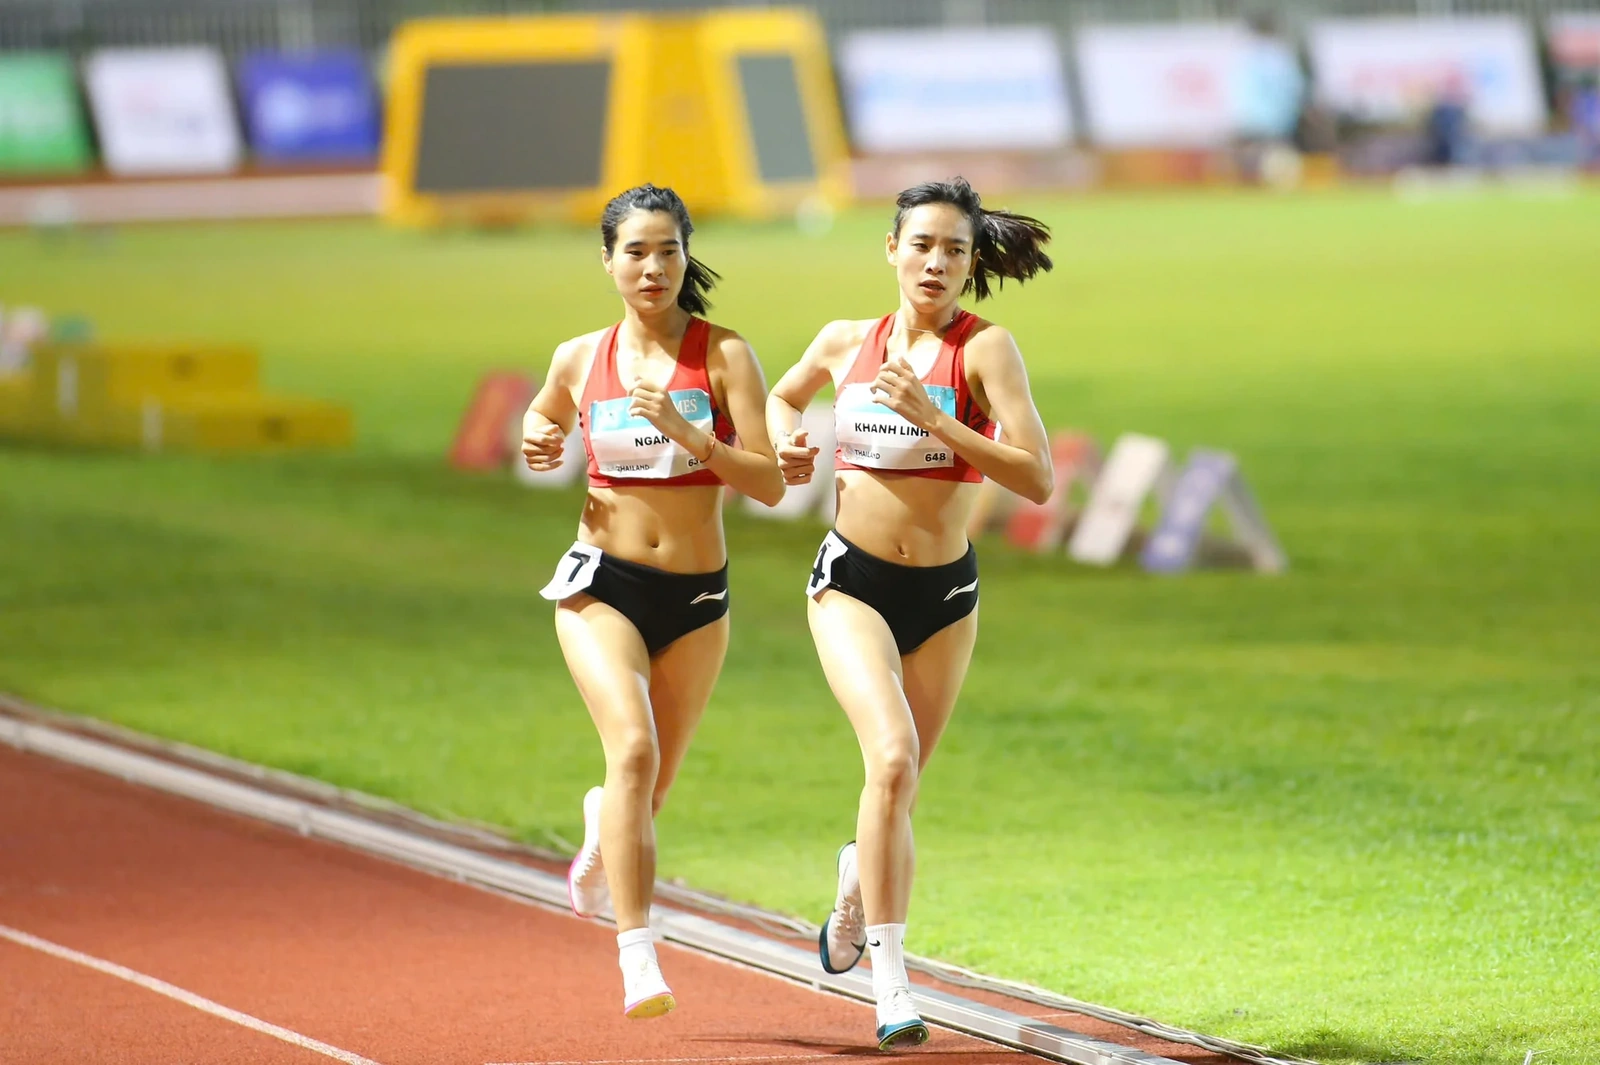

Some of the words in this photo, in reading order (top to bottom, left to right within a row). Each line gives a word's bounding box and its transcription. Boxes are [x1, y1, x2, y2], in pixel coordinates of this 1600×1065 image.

[854, 422, 897, 435] KHANH
[899, 425, 930, 437] LINH
[634, 435, 670, 447] NGAN
[925, 453, 946, 462] 648
[567, 550, 591, 582] 7
[811, 542, 828, 588] 4
